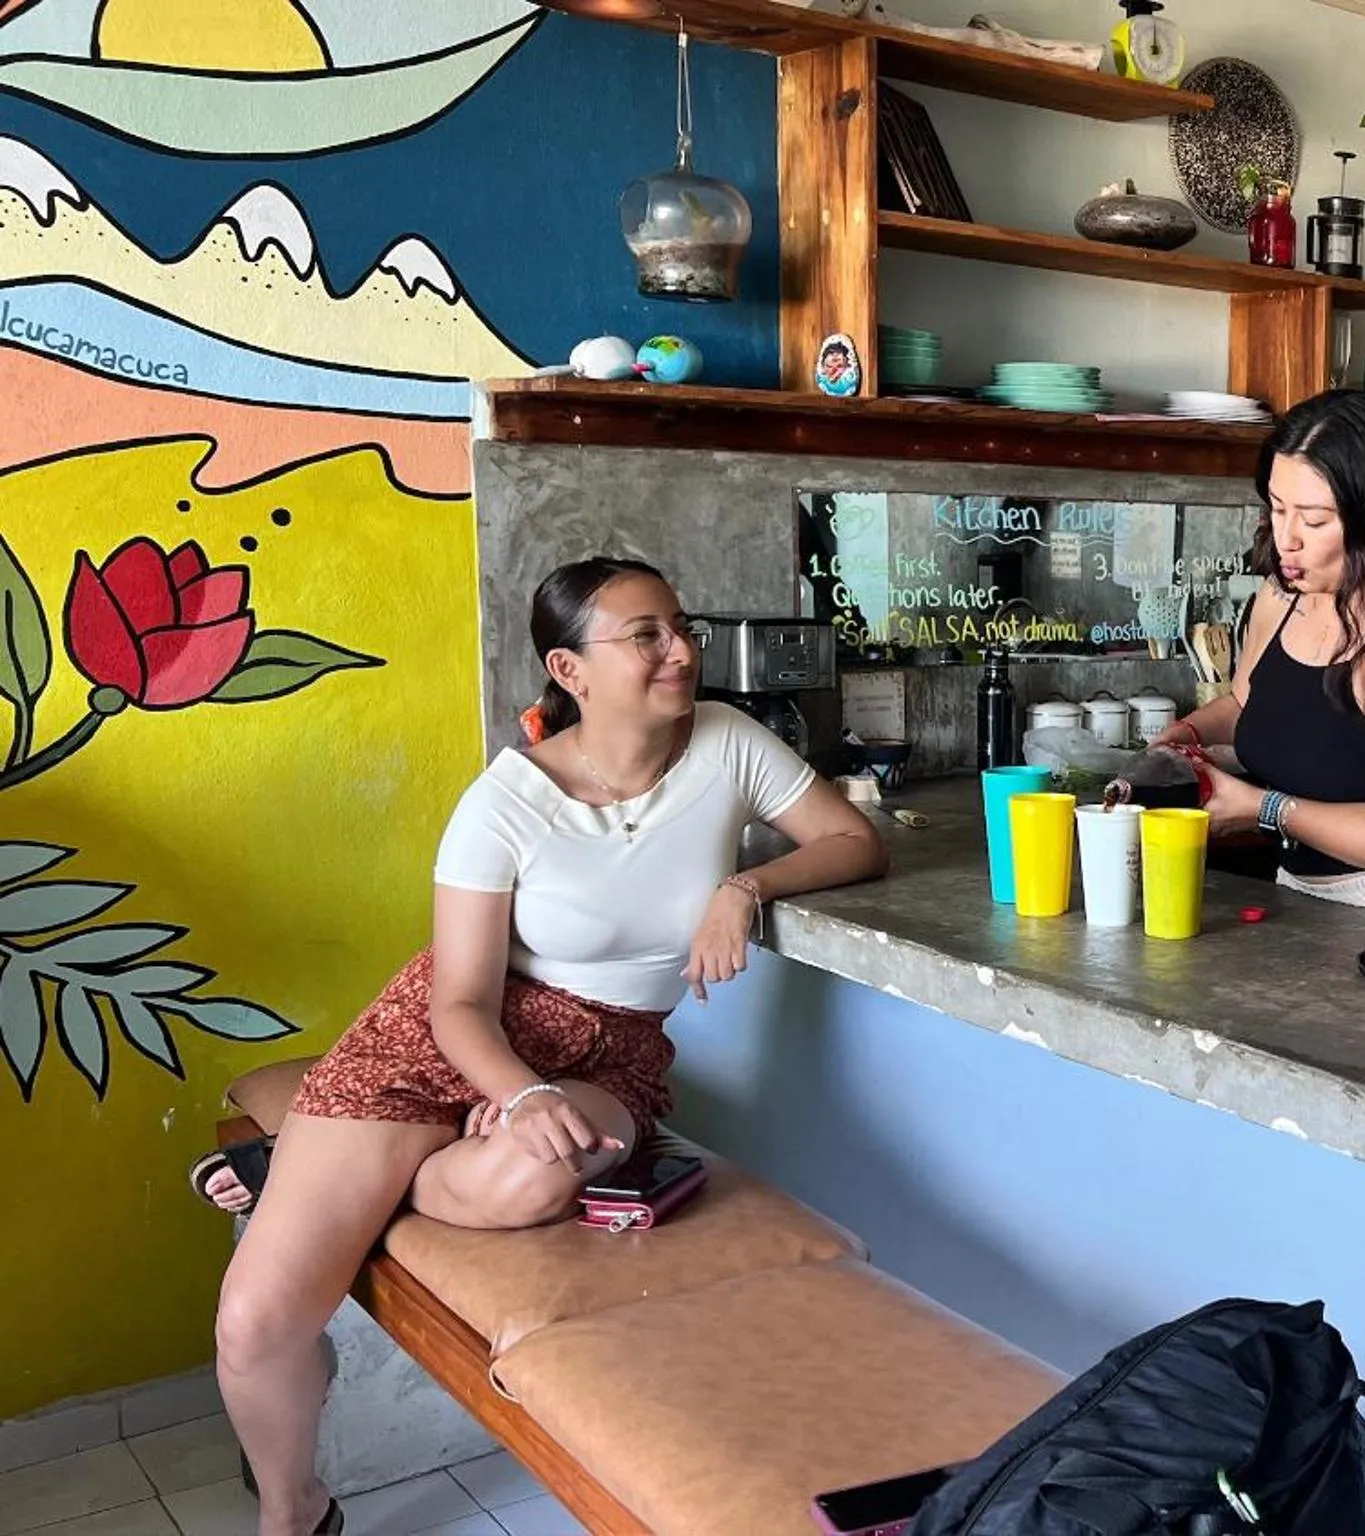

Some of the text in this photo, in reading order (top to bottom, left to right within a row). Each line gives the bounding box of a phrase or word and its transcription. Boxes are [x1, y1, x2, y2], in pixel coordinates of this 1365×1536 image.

[932, 496, 1042, 531] Kitchen
[809, 553, 828, 577] 1.
[1092, 553, 1112, 581] 3.
[832, 582, 1003, 610] Qutions later.
[1024, 614, 1085, 643] drama.
